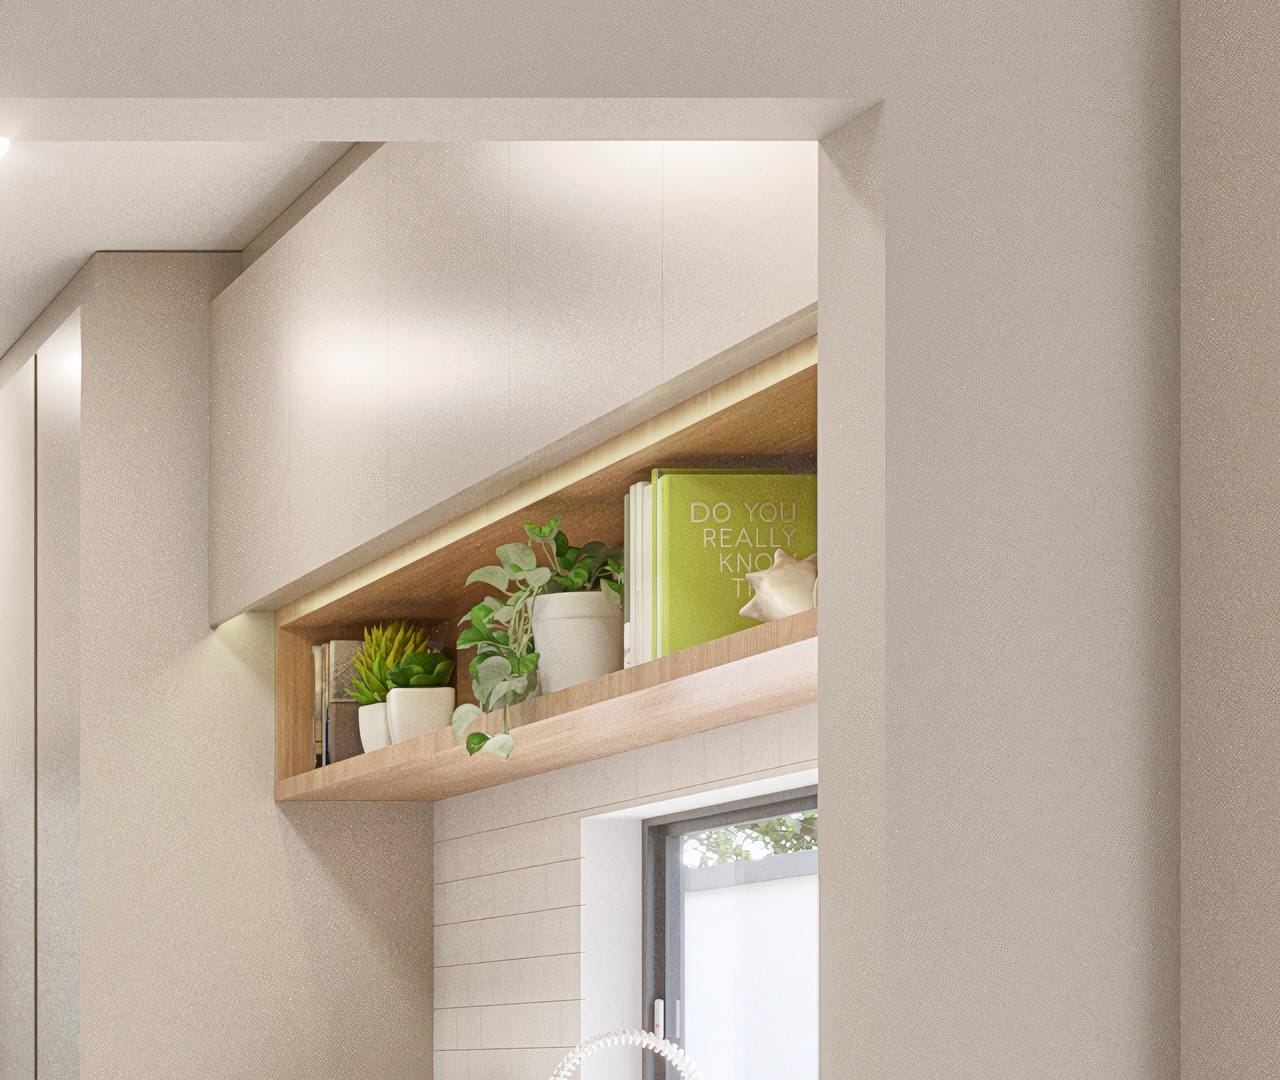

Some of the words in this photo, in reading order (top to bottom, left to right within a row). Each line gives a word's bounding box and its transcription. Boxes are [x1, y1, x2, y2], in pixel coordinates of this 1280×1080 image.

[690, 502, 732, 523] DO
[744, 502, 797, 523] YOU
[703, 527, 797, 548] REALLY
[719, 552, 774, 573] KNO
